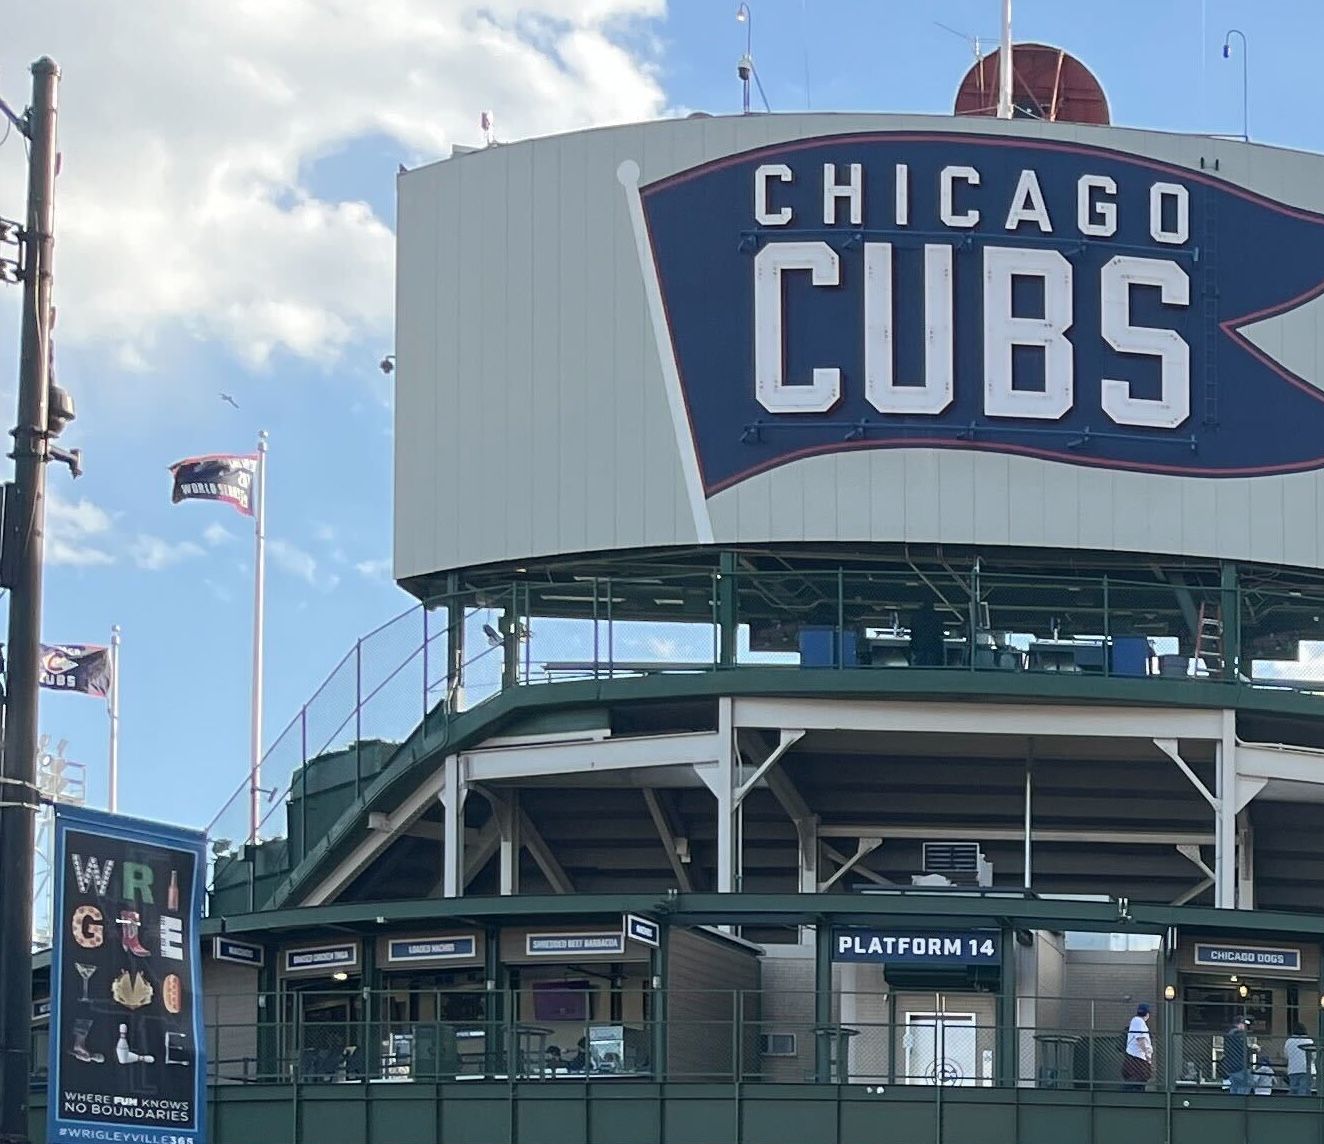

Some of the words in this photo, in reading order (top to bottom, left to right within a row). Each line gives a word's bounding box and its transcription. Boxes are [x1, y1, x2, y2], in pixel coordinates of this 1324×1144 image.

[755, 163, 1189, 245] CHICAGO
[754, 241, 1190, 429] CUBS
[839, 936, 962, 956] PLATFORM
[969, 939, 995, 956] 14
[1211, 950, 1256, 963] CHICAGO
[1257, 953, 1285, 964] DOGS
[64, 1091, 111, 1104] WHERE
[141, 1099, 190, 1111] KNOWS
[64, 1102, 87, 1113] NO
[91, 1103, 190, 1123] BOUNDARIES
